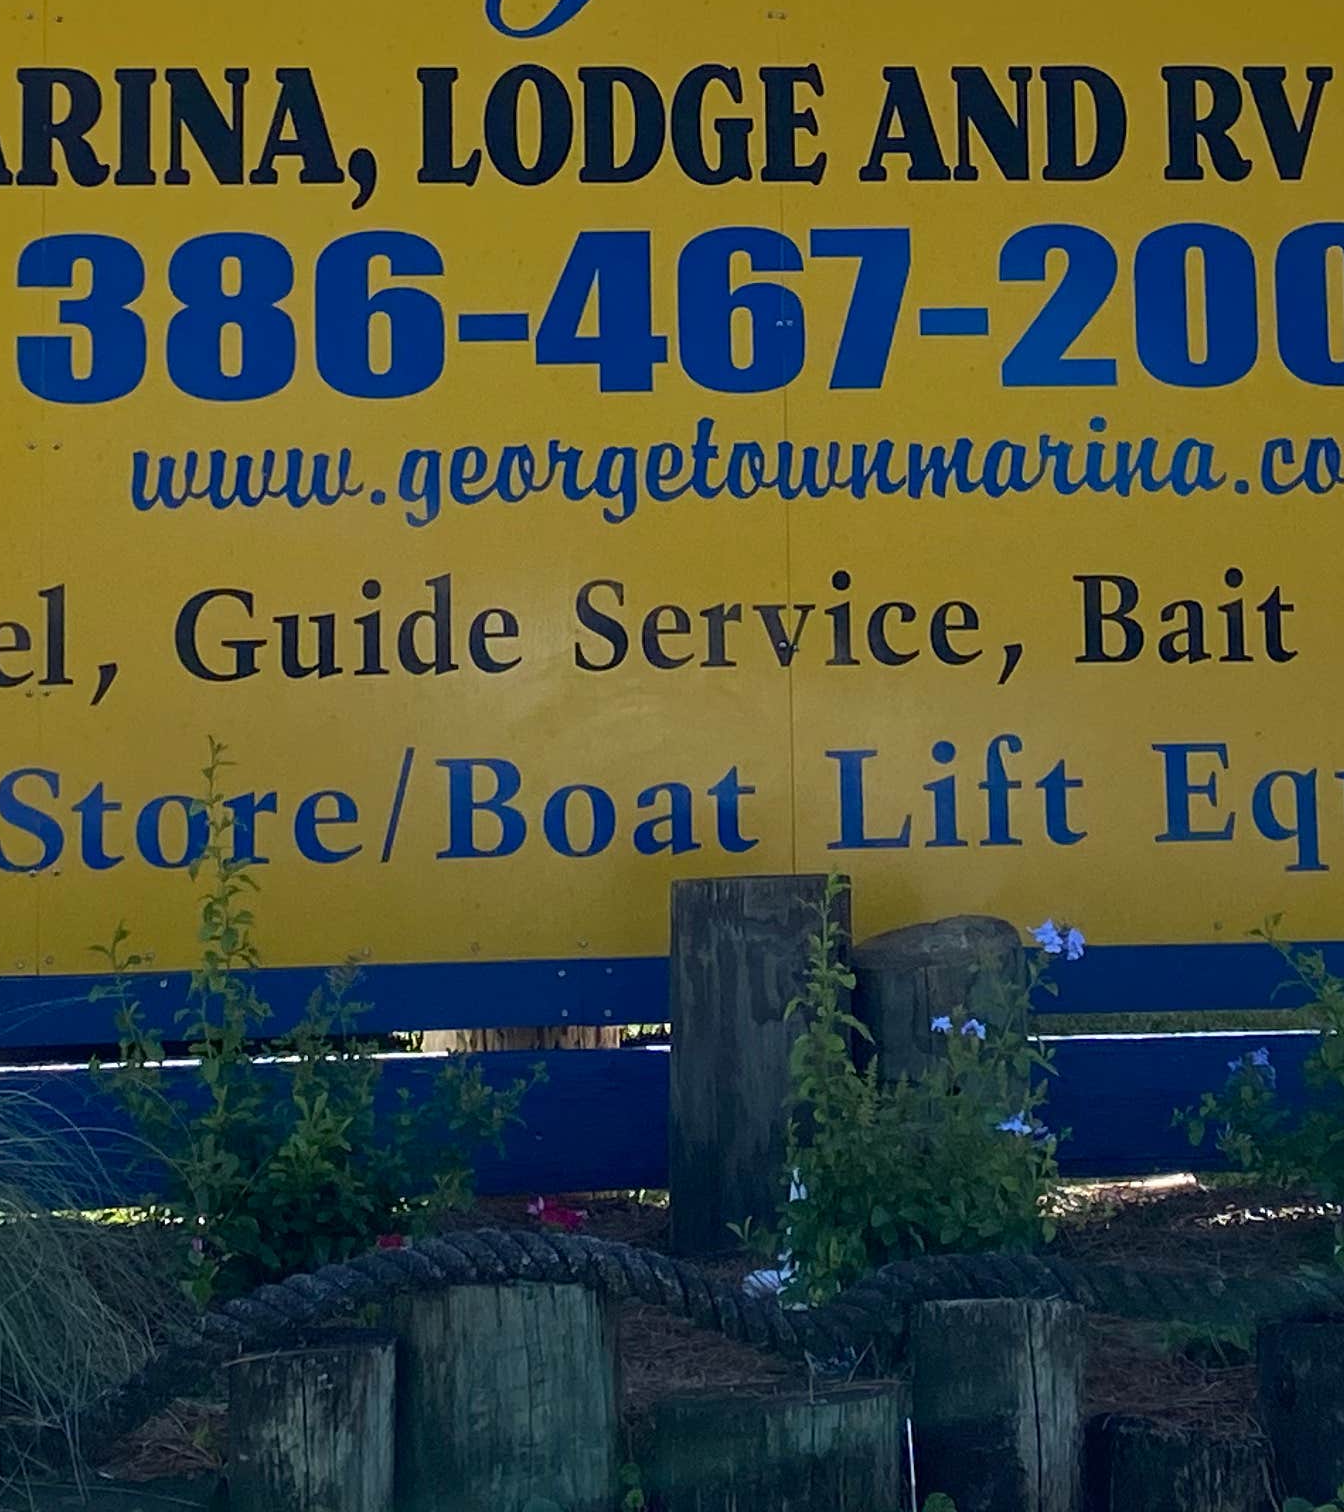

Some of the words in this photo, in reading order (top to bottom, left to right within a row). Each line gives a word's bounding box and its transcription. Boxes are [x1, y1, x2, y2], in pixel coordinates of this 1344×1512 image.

[416, 63, 827, 188] LODGE
[859, 65, 1128, 183] AND
[1162, 65, 1333, 183] RV
[175, 572, 522, 682] Guide
[574, 570, 1023, 686] Service,
[1074, 567, 1300, 665] Bait
[825, 734, 1087, 850] Lift
